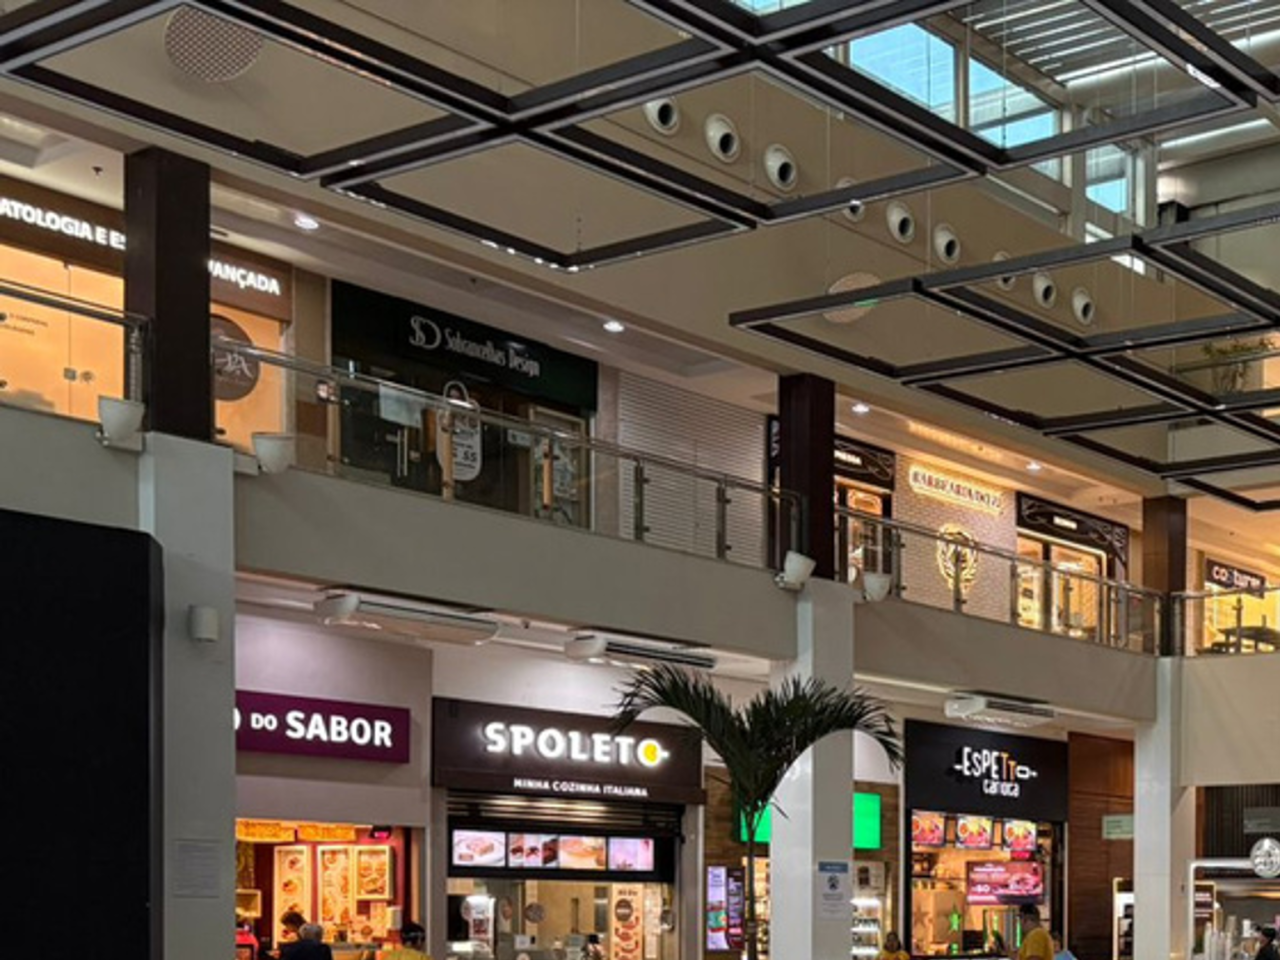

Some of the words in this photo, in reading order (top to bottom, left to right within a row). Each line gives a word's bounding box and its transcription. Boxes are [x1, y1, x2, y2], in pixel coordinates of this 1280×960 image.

[95, 225, 108, 246] E
[250, 712, 278, 731] DO
[285, 710, 393, 748] SABOR
[484, 721, 670, 768] SPOLETO
[513, 778, 550, 790] MINHA
[552, 781, 600, 794] COZINHA
[603, 785, 648, 797] ITALIANA
